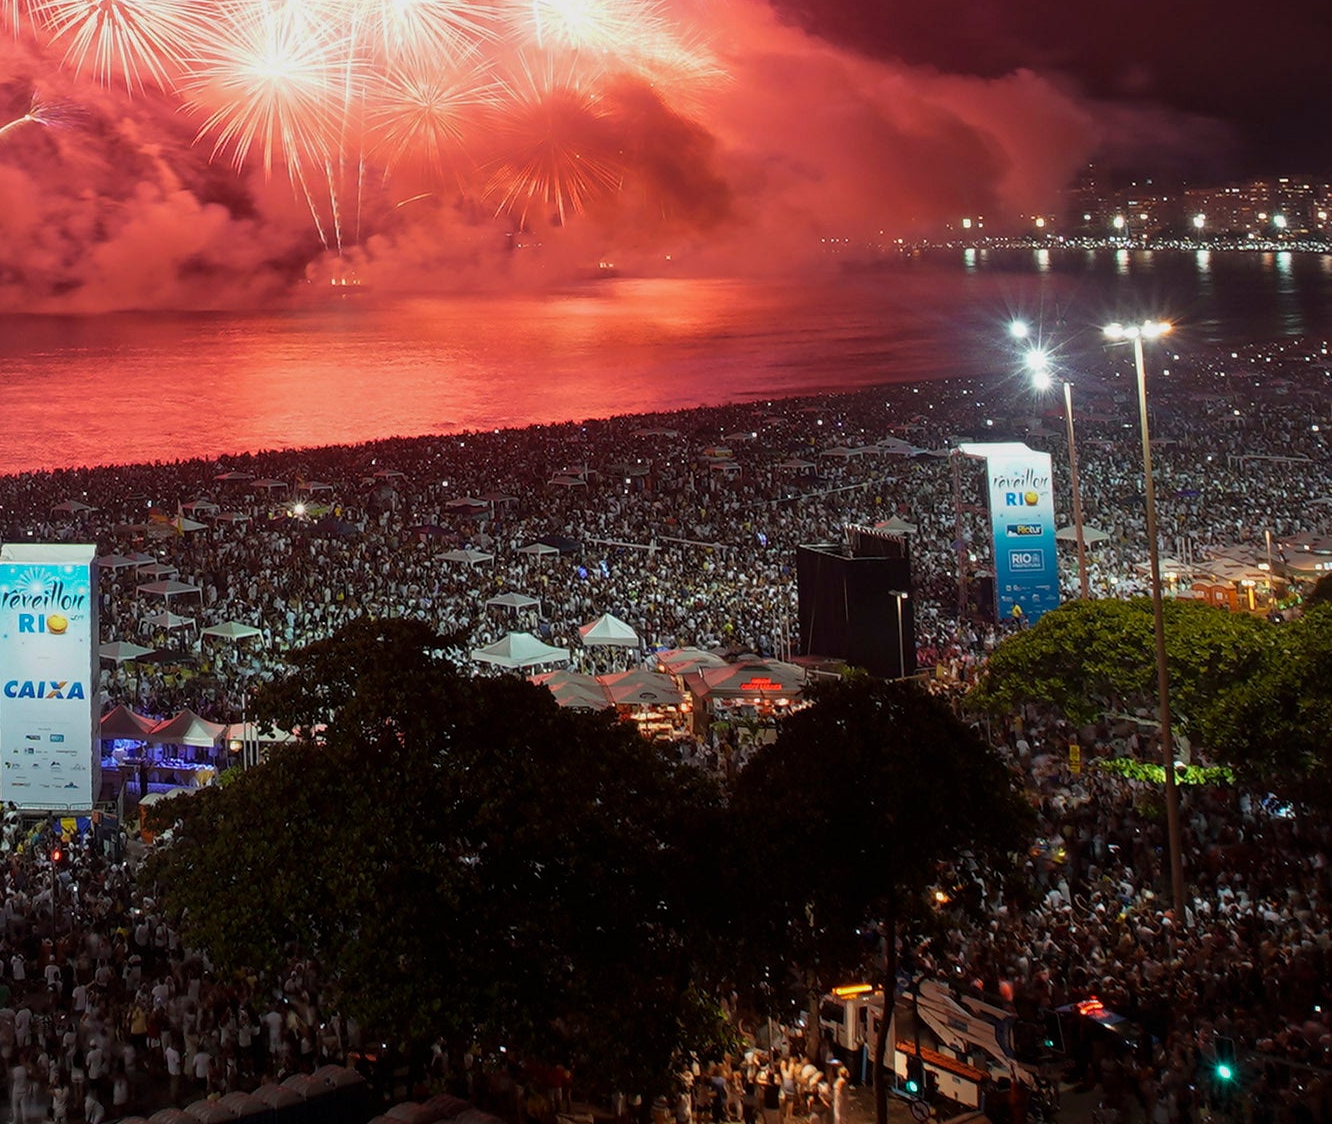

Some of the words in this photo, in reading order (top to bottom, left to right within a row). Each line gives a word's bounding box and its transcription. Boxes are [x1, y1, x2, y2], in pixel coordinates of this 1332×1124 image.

[1005, 491, 1038, 506] RIO
[1011, 553, 1032, 564] RIO
[18, 613, 69, 635] RIO
[3, 680, 85, 700] CAIXA
